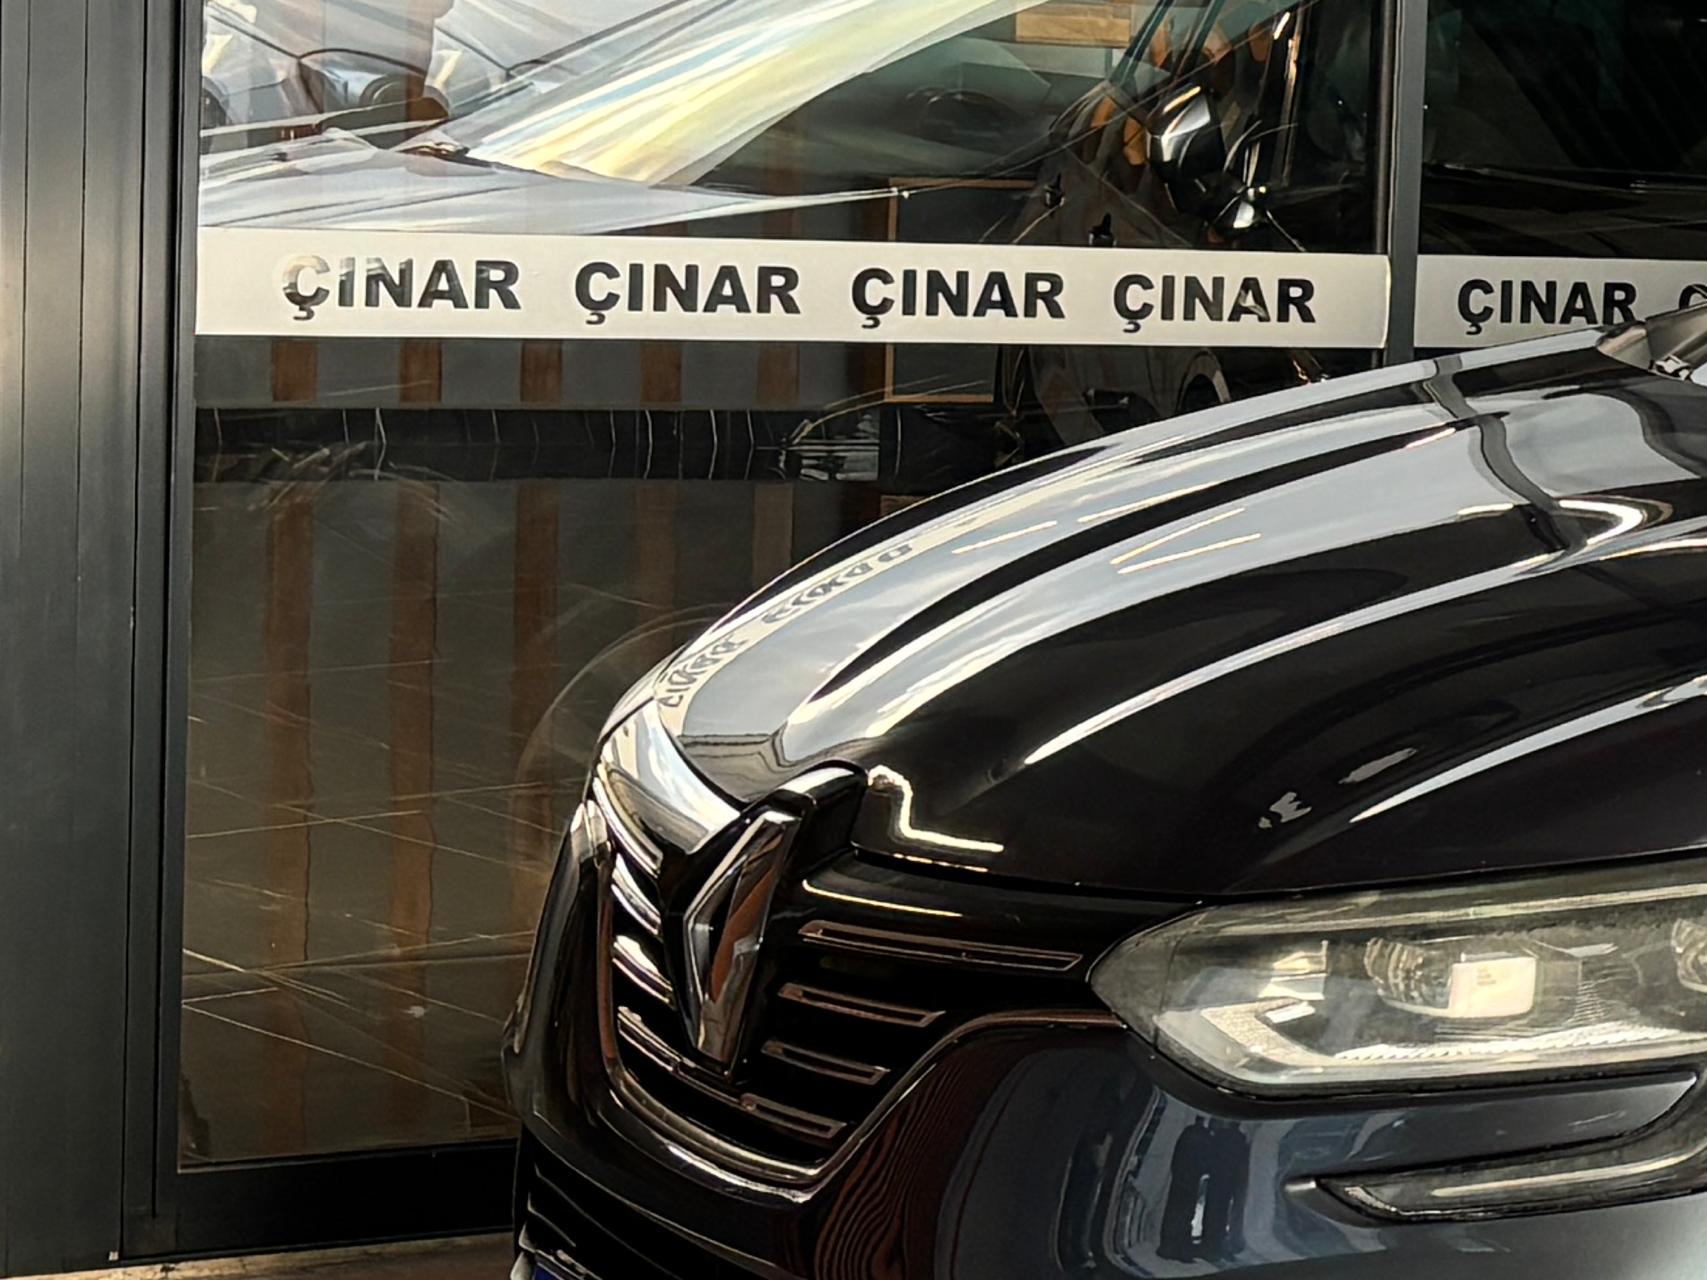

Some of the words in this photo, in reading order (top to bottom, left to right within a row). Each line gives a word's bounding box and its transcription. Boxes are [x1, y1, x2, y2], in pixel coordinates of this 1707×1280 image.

[283, 256, 521, 321] ÇINAR
[574, 261, 801, 325] ÇINAR
[850, 266, 1065, 329] ÇINAR
[1112, 273, 1316, 334] ÇINAR
[1457, 278, 1637, 336] ÇINAR
